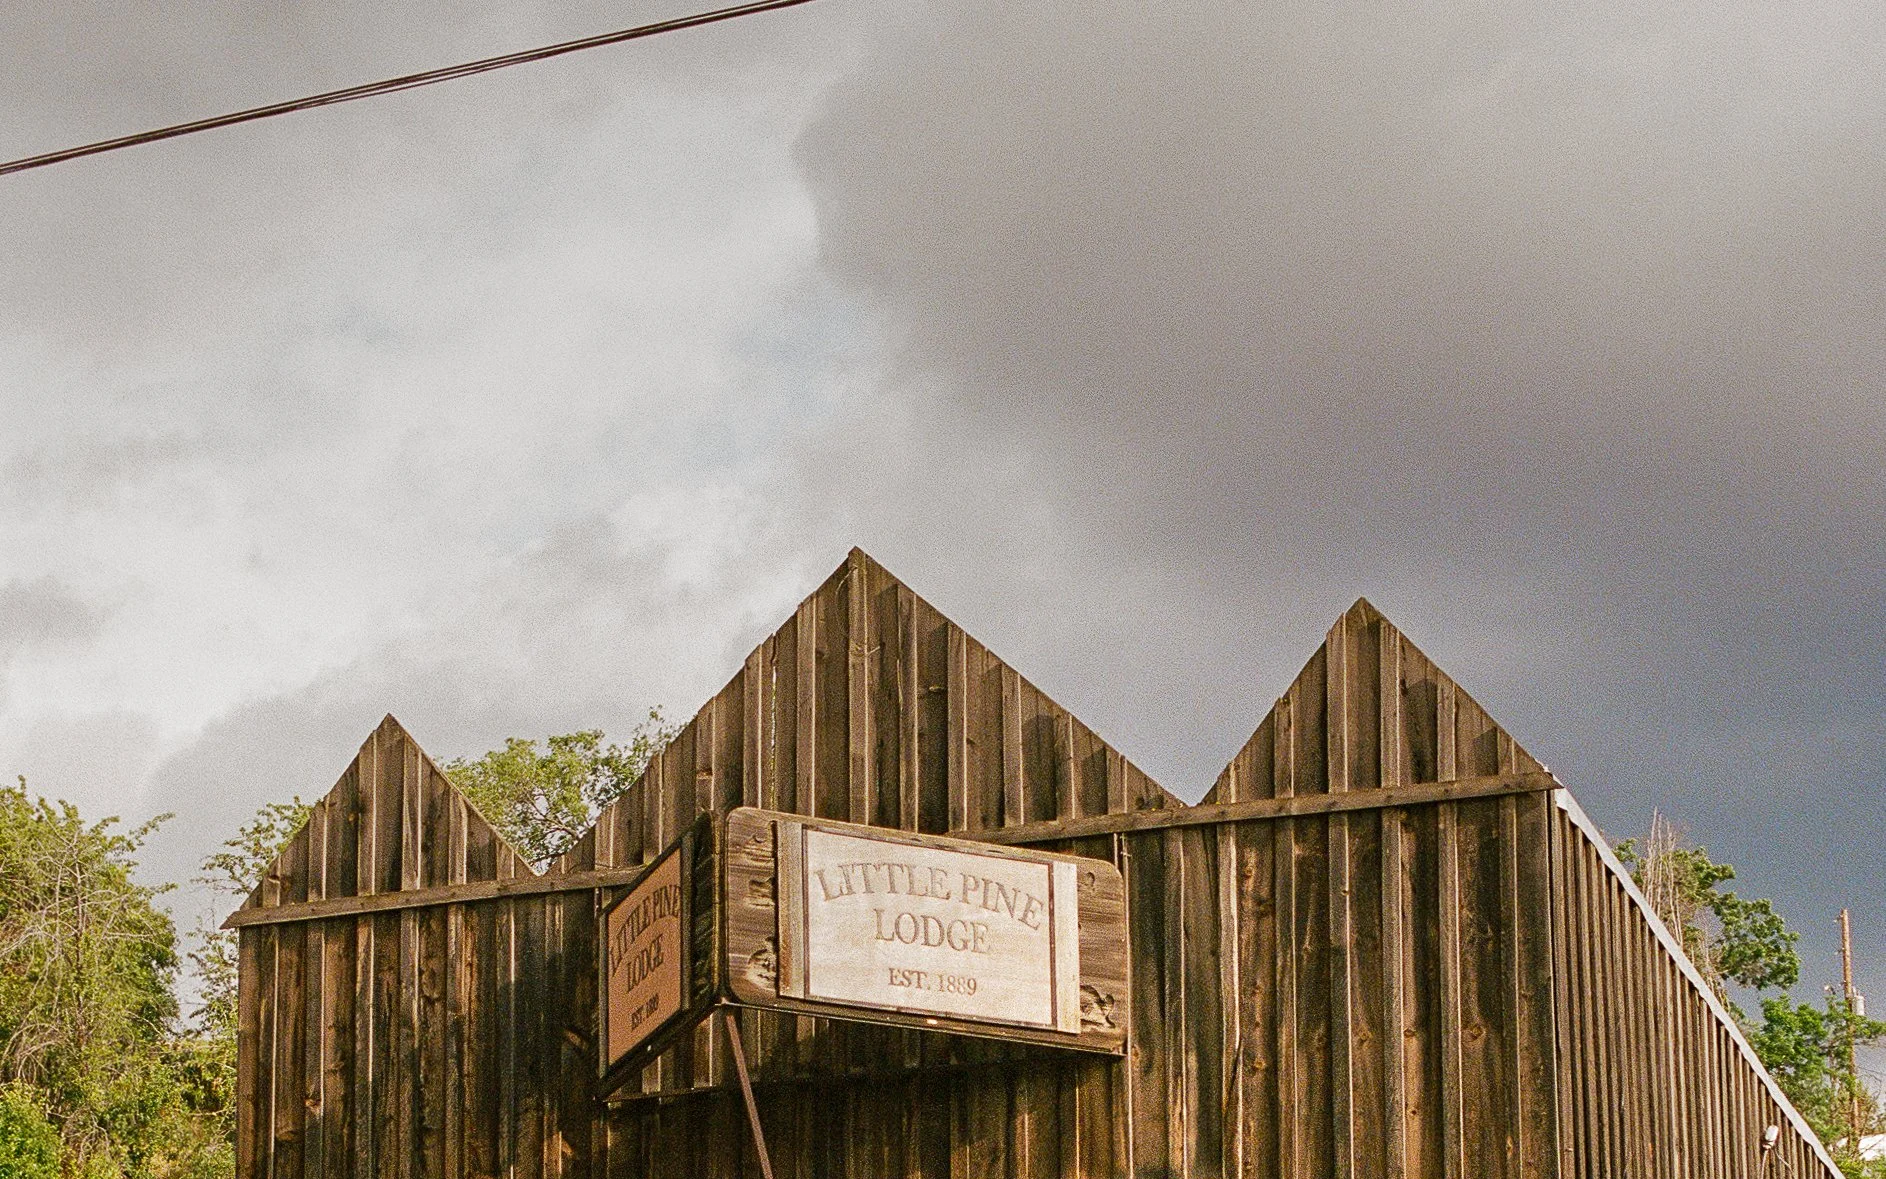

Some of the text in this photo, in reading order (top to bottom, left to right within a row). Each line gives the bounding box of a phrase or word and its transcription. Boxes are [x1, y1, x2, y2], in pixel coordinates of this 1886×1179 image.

[813, 862, 1044, 931] LITTLE PINE
[609, 884, 681, 978] LITTLE PINE
[873, 908, 990, 954] LODGE
[627, 932, 665, 993] LODGE
[888, 967, 977, 997] EST. 1889
